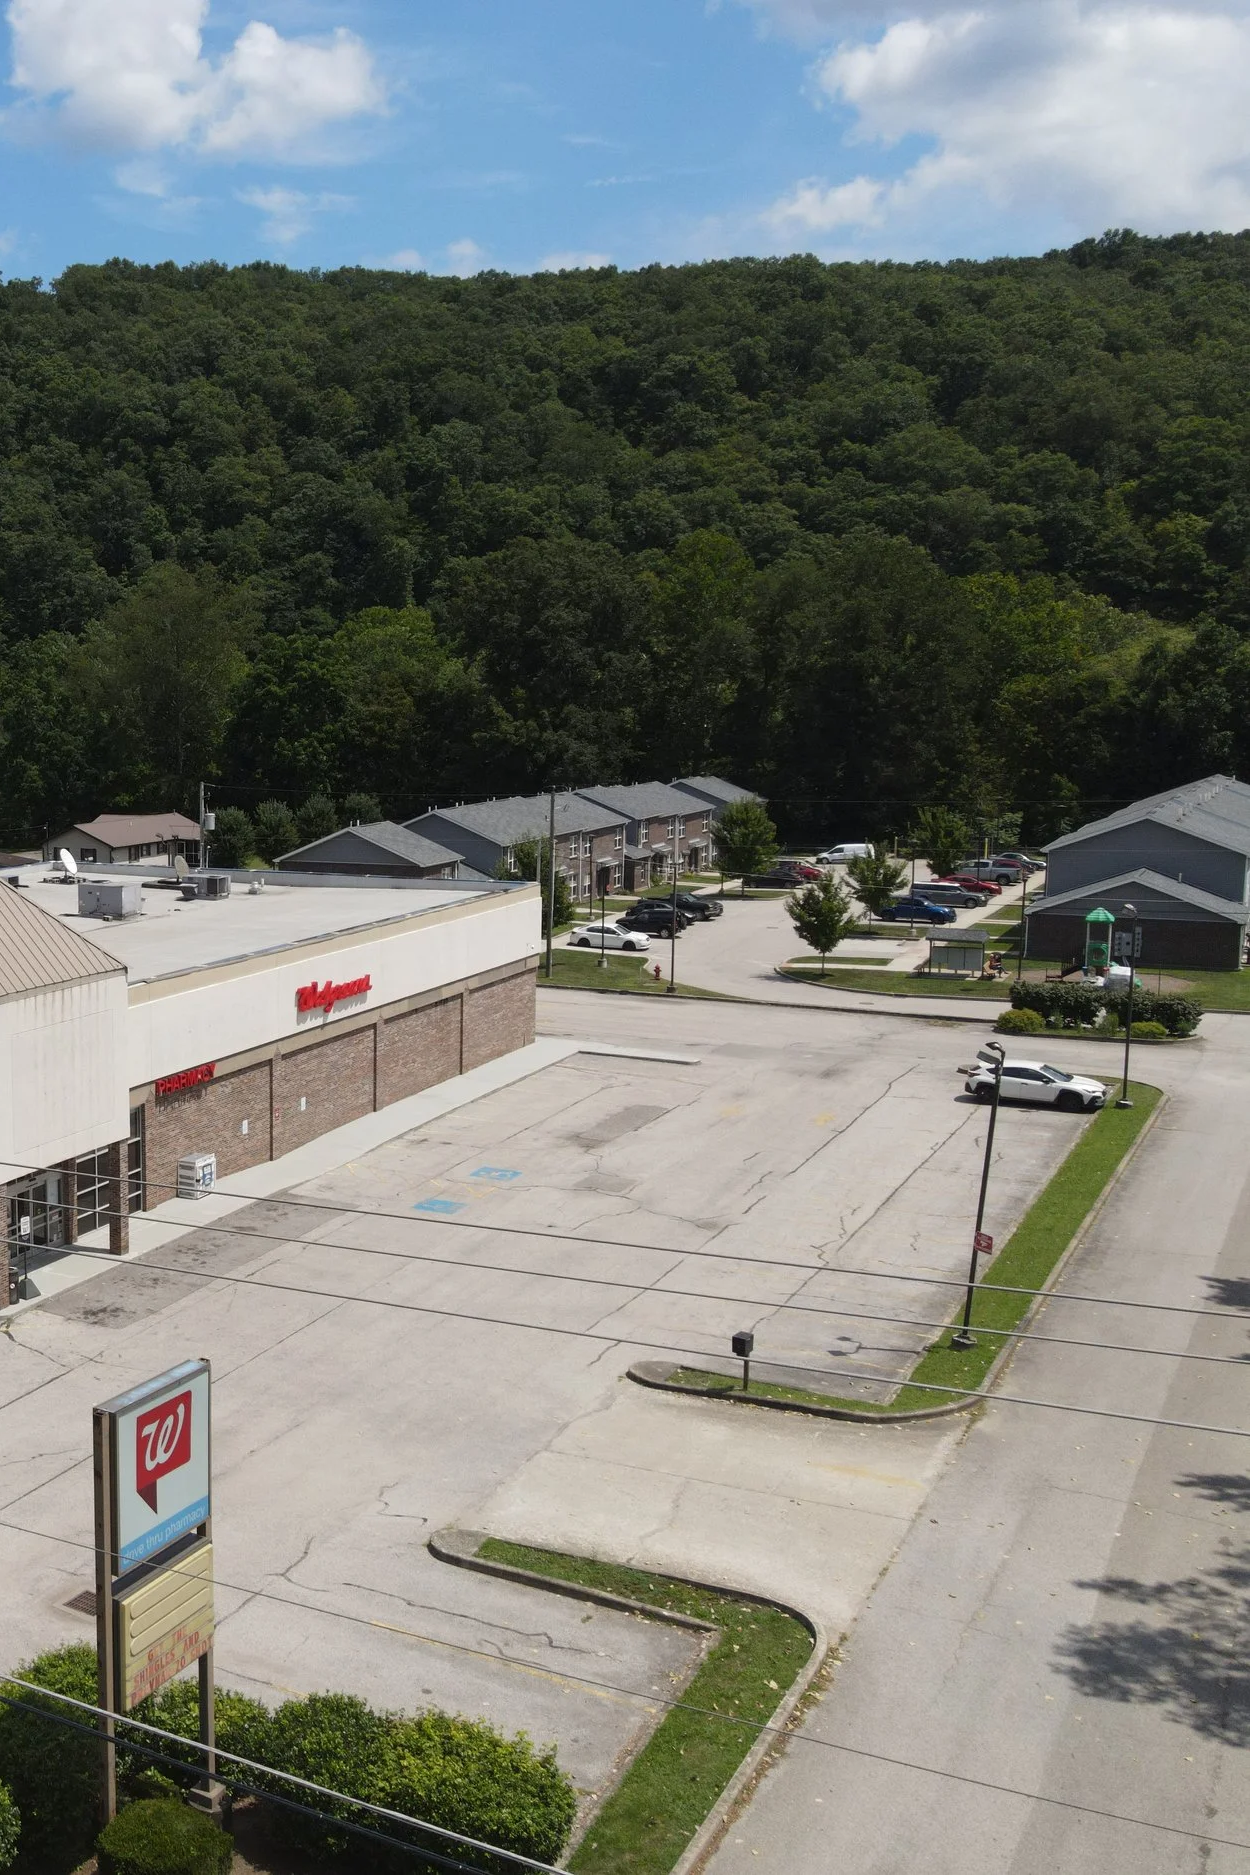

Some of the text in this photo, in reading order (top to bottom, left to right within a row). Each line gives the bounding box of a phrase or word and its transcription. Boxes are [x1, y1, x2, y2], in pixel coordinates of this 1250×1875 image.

[297, 974, 372, 1013] Walgreens
[155, 1061, 216, 1096] PHARMACY
[123, 1505, 205, 1565] drive thru pharmacy
[134, 1631, 199, 1688] SHINGLES AND
